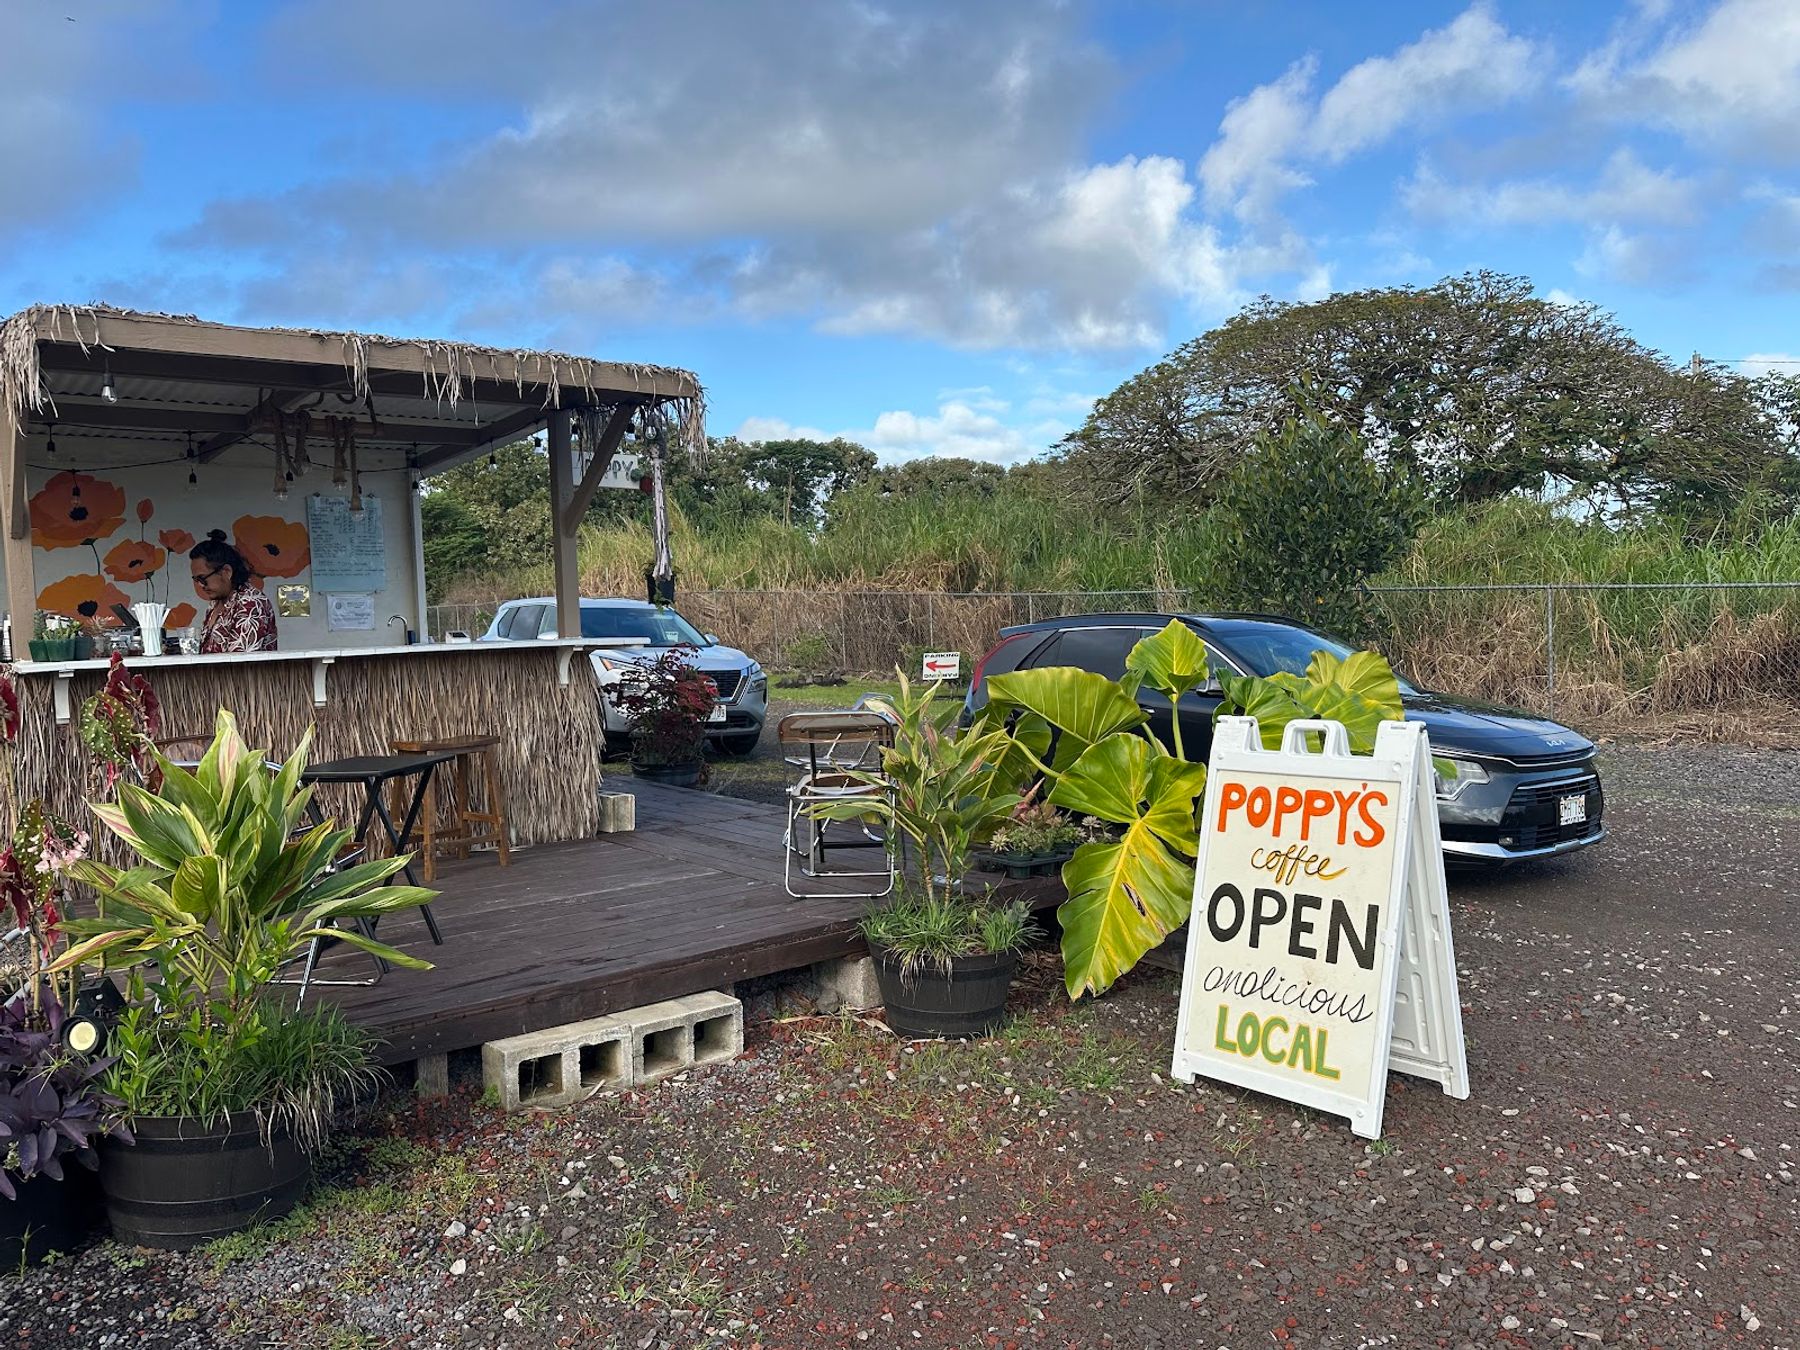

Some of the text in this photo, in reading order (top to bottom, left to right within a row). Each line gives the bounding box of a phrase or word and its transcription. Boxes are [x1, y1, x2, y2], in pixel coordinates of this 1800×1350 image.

[1217, 782, 1388, 848] POPPY'S
[1251, 844, 1350, 886] coffee
[1207, 883, 1380, 970] OPEN
[1215, 1004, 1342, 1081] LOCAL
